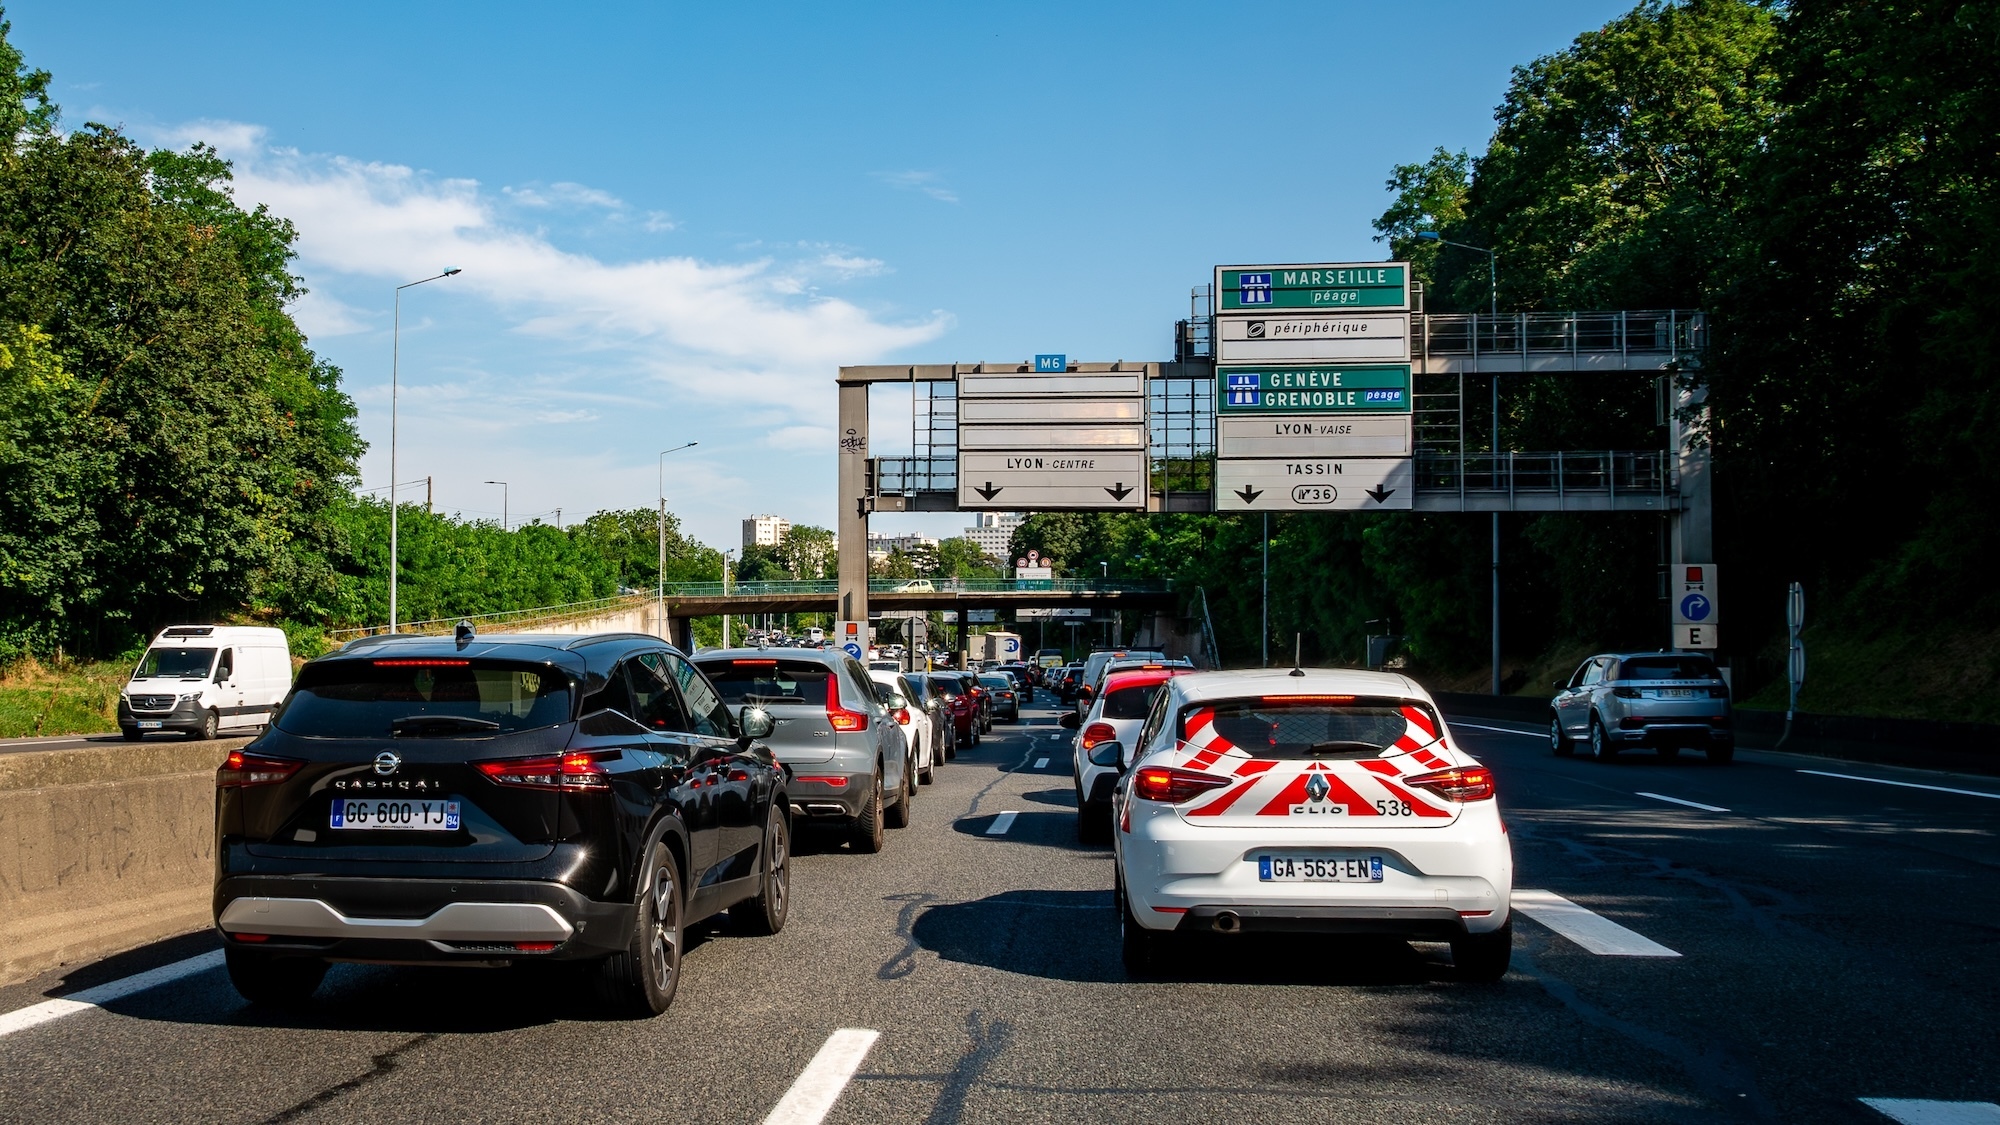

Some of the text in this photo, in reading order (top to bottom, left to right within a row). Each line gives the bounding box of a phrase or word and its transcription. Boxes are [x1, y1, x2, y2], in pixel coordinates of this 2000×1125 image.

[1284, 270, 1386, 285] MARSEILLE
[1314, 290, 1357, 303] péage
[1274, 322, 1368, 335] périphérique
[1270, 371, 1342, 387] GENÈVE
[1265, 392, 1355, 406] GRENOBLE
[1286, 463, 1343, 475] TASSIN
[1312, 489, 1331, 500] 36
[1690, 629, 1701, 644] E
[335, 780, 440, 790] QASHQAI
[346, 802, 444, 824] GG-600-YJ
[446, 815, 457, 826] 94
[1293, 806, 1343, 814] CLIO
[1376, 800, 1412, 817] 538
[1273, 858, 1369, 878] GA-563-EN
[1372, 869, 1382, 878] 69
